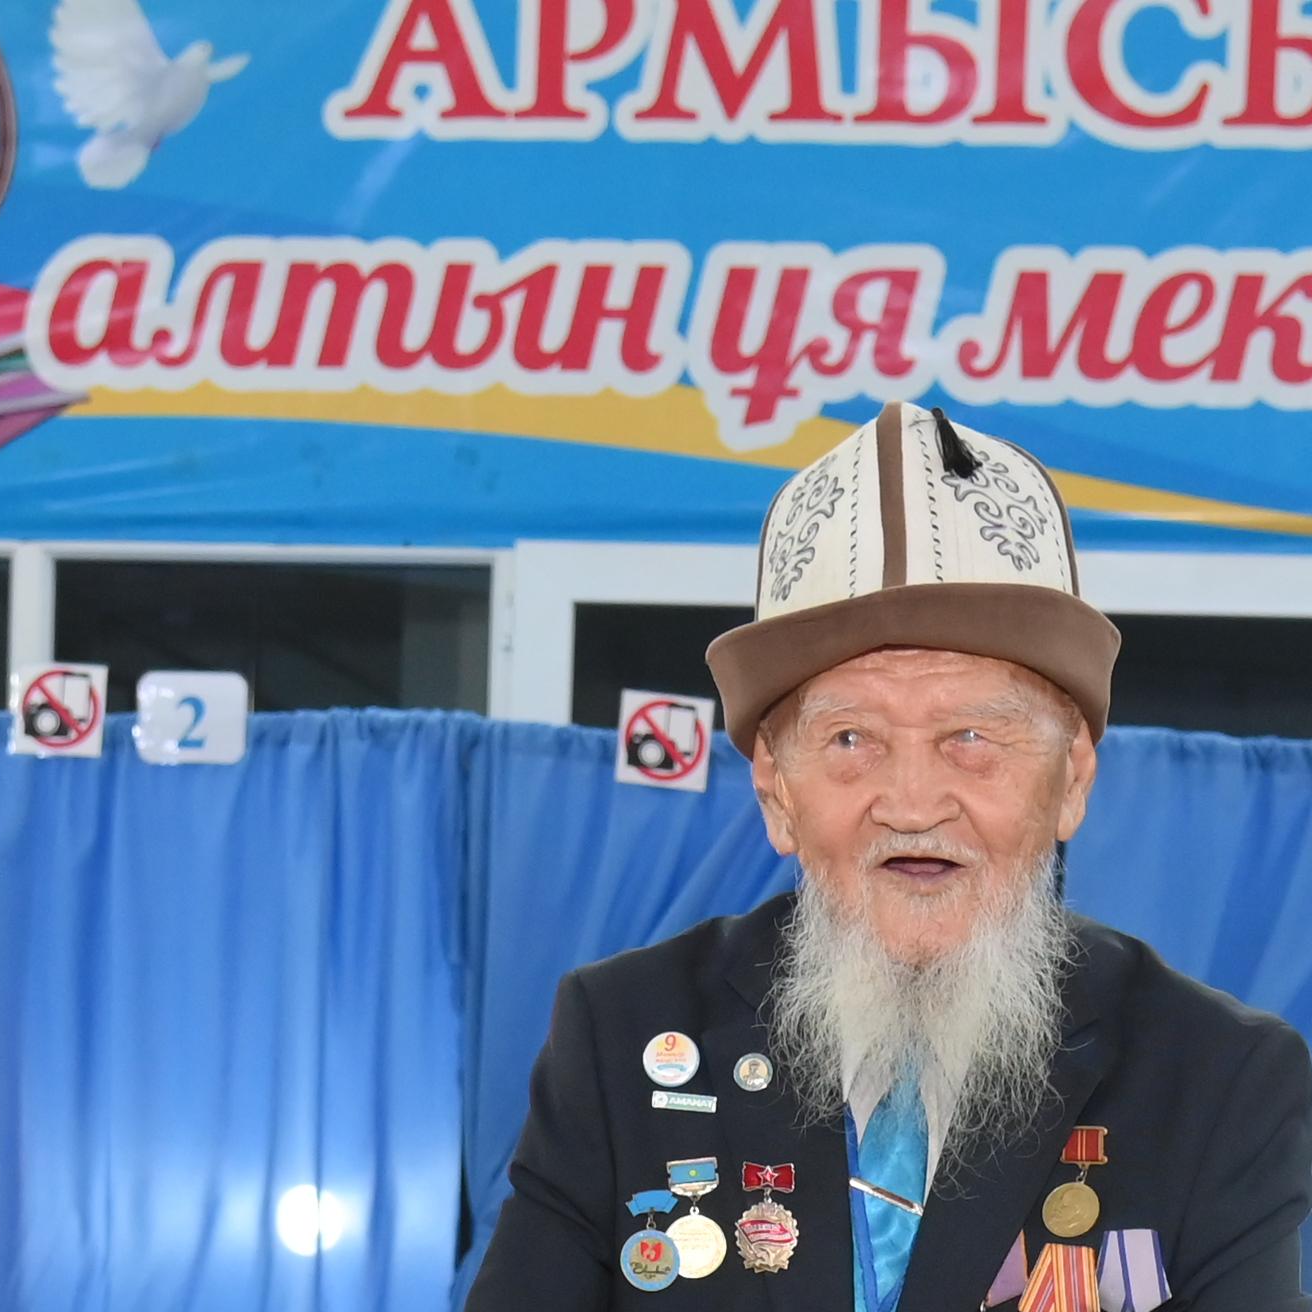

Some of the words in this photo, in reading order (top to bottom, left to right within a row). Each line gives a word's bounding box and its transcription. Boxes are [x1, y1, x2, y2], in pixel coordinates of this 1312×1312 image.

[46, 257, 665, 373] алтын
[176, 696, 207, 748] 2
[664, 1034, 676, 1052] 9
